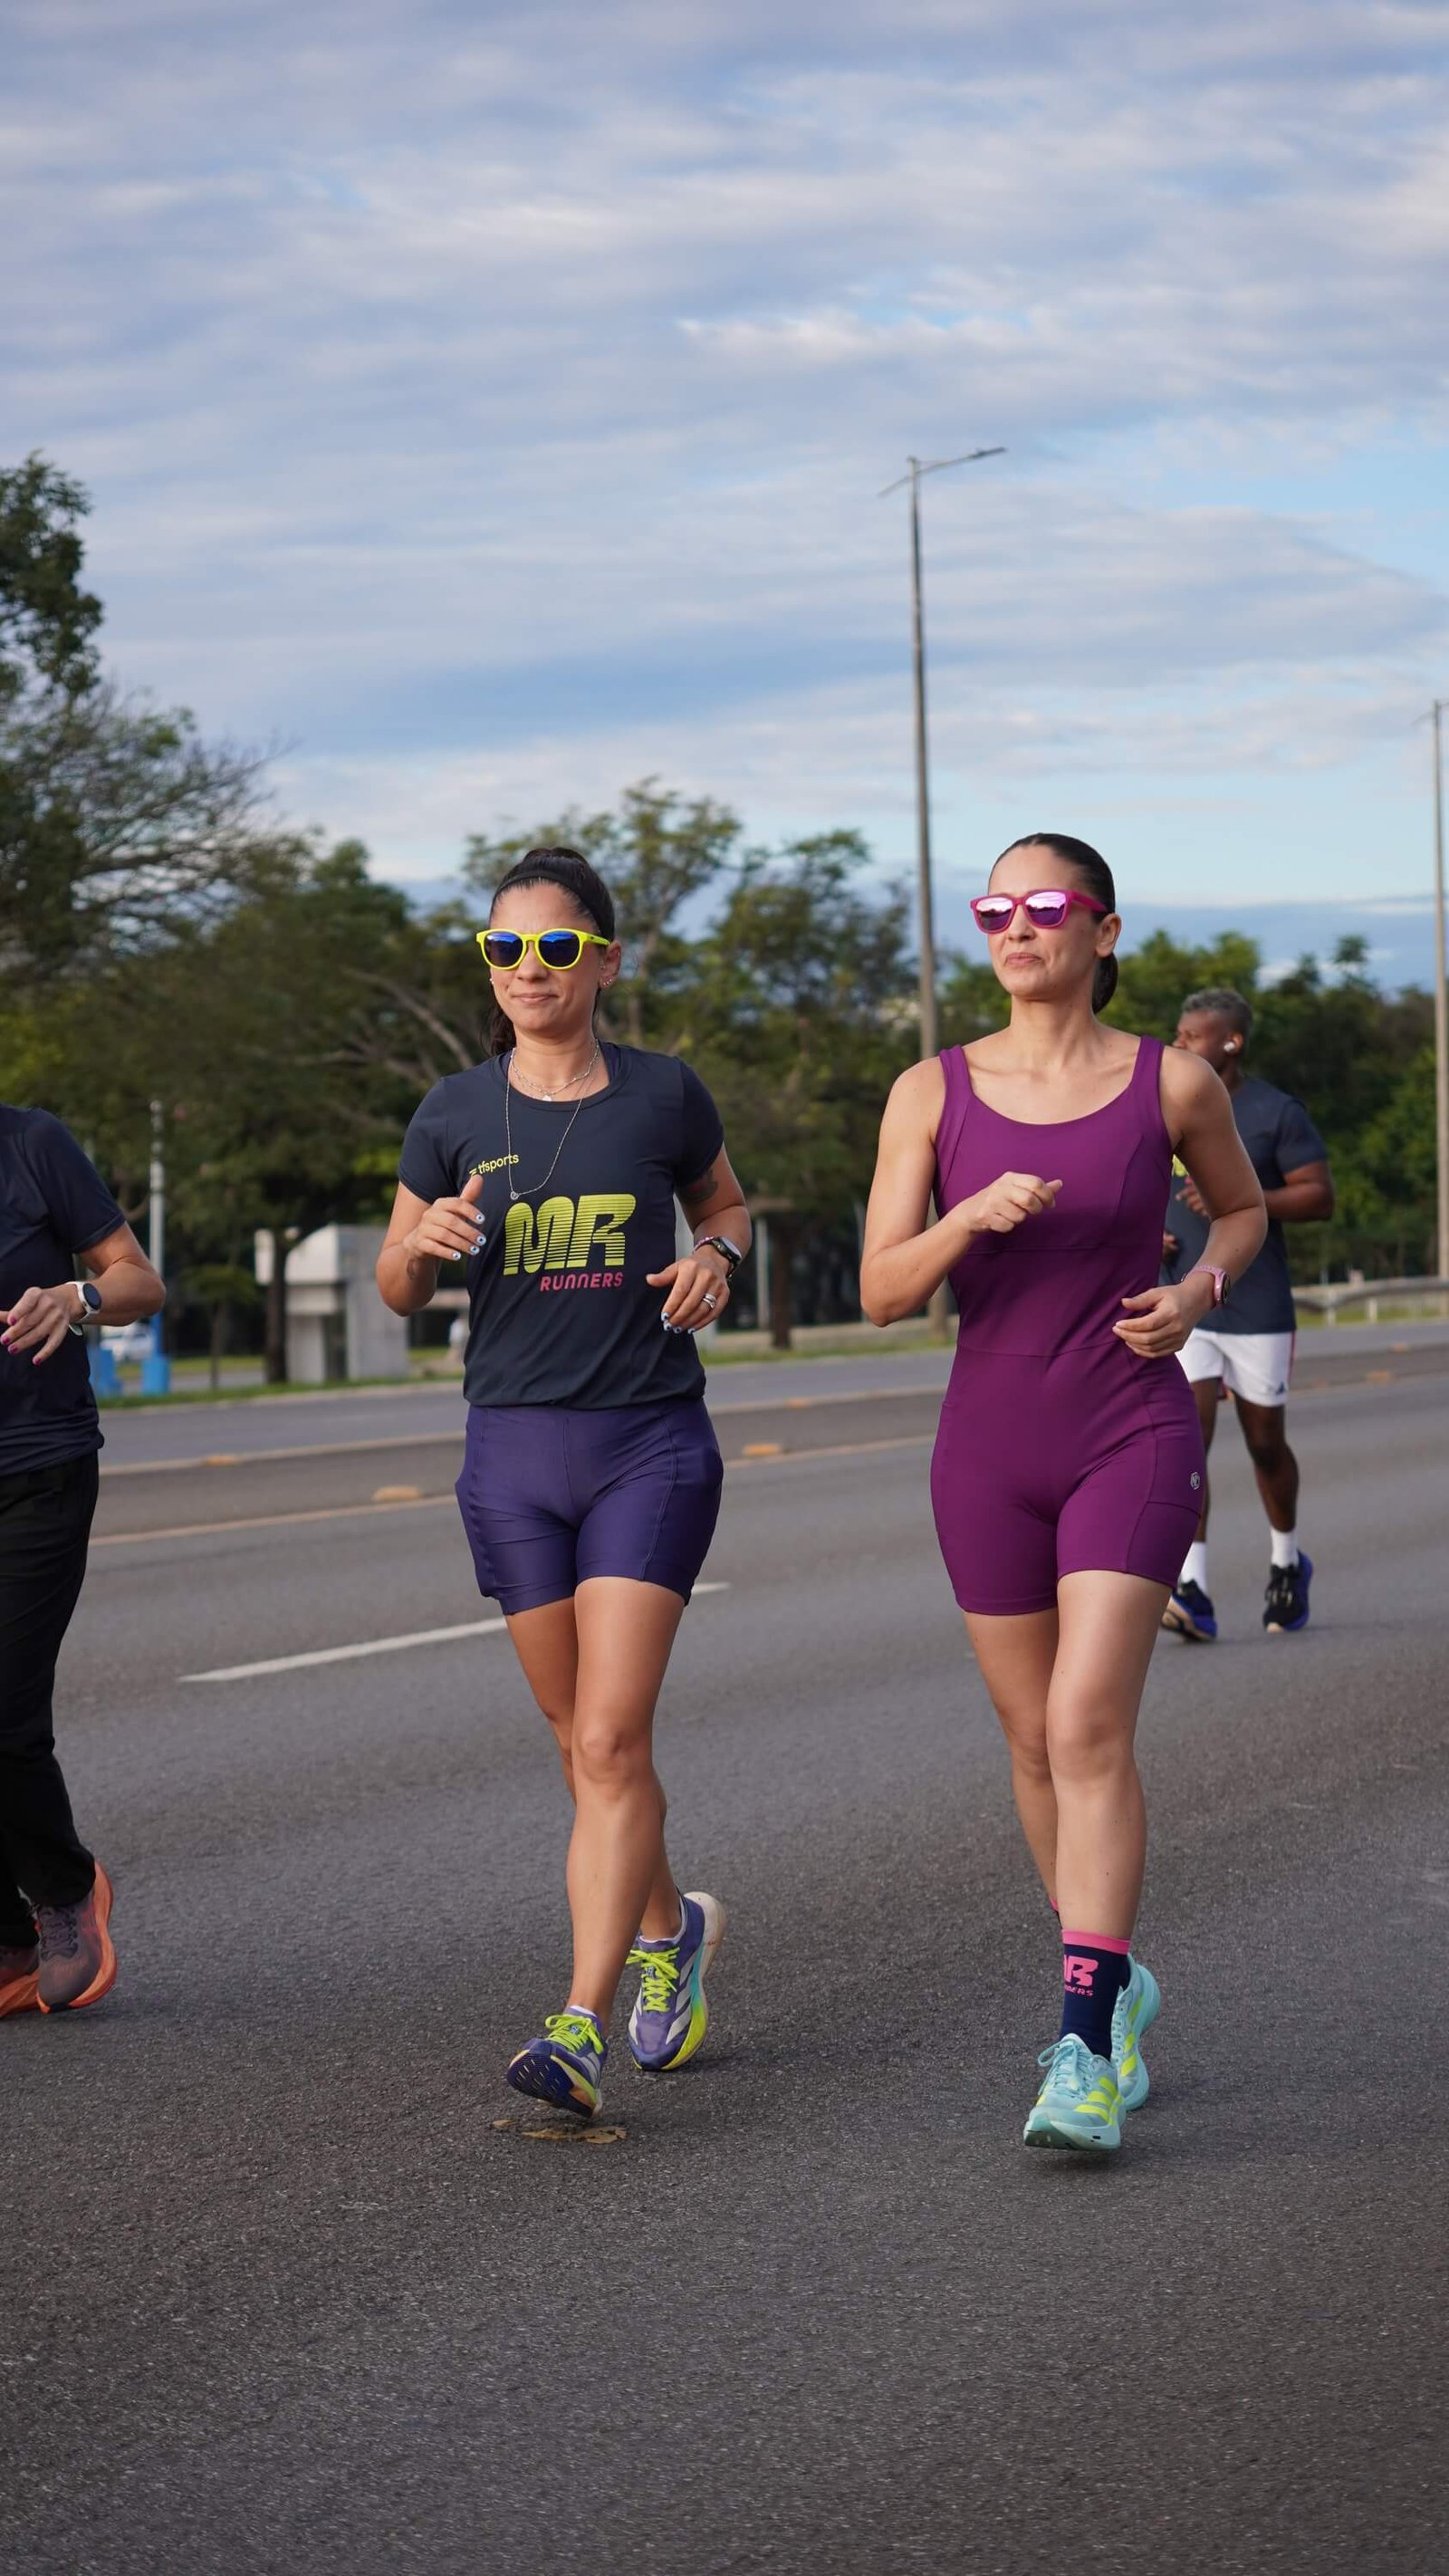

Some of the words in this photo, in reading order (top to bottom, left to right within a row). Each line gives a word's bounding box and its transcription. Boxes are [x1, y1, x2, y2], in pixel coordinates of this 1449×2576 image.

[477, 1154, 520, 1175] tfsports
[503, 1193, 636, 1275] MR
[540, 1272, 624, 1293] RUNNERS
[1063, 1954, 1099, 1987] R
